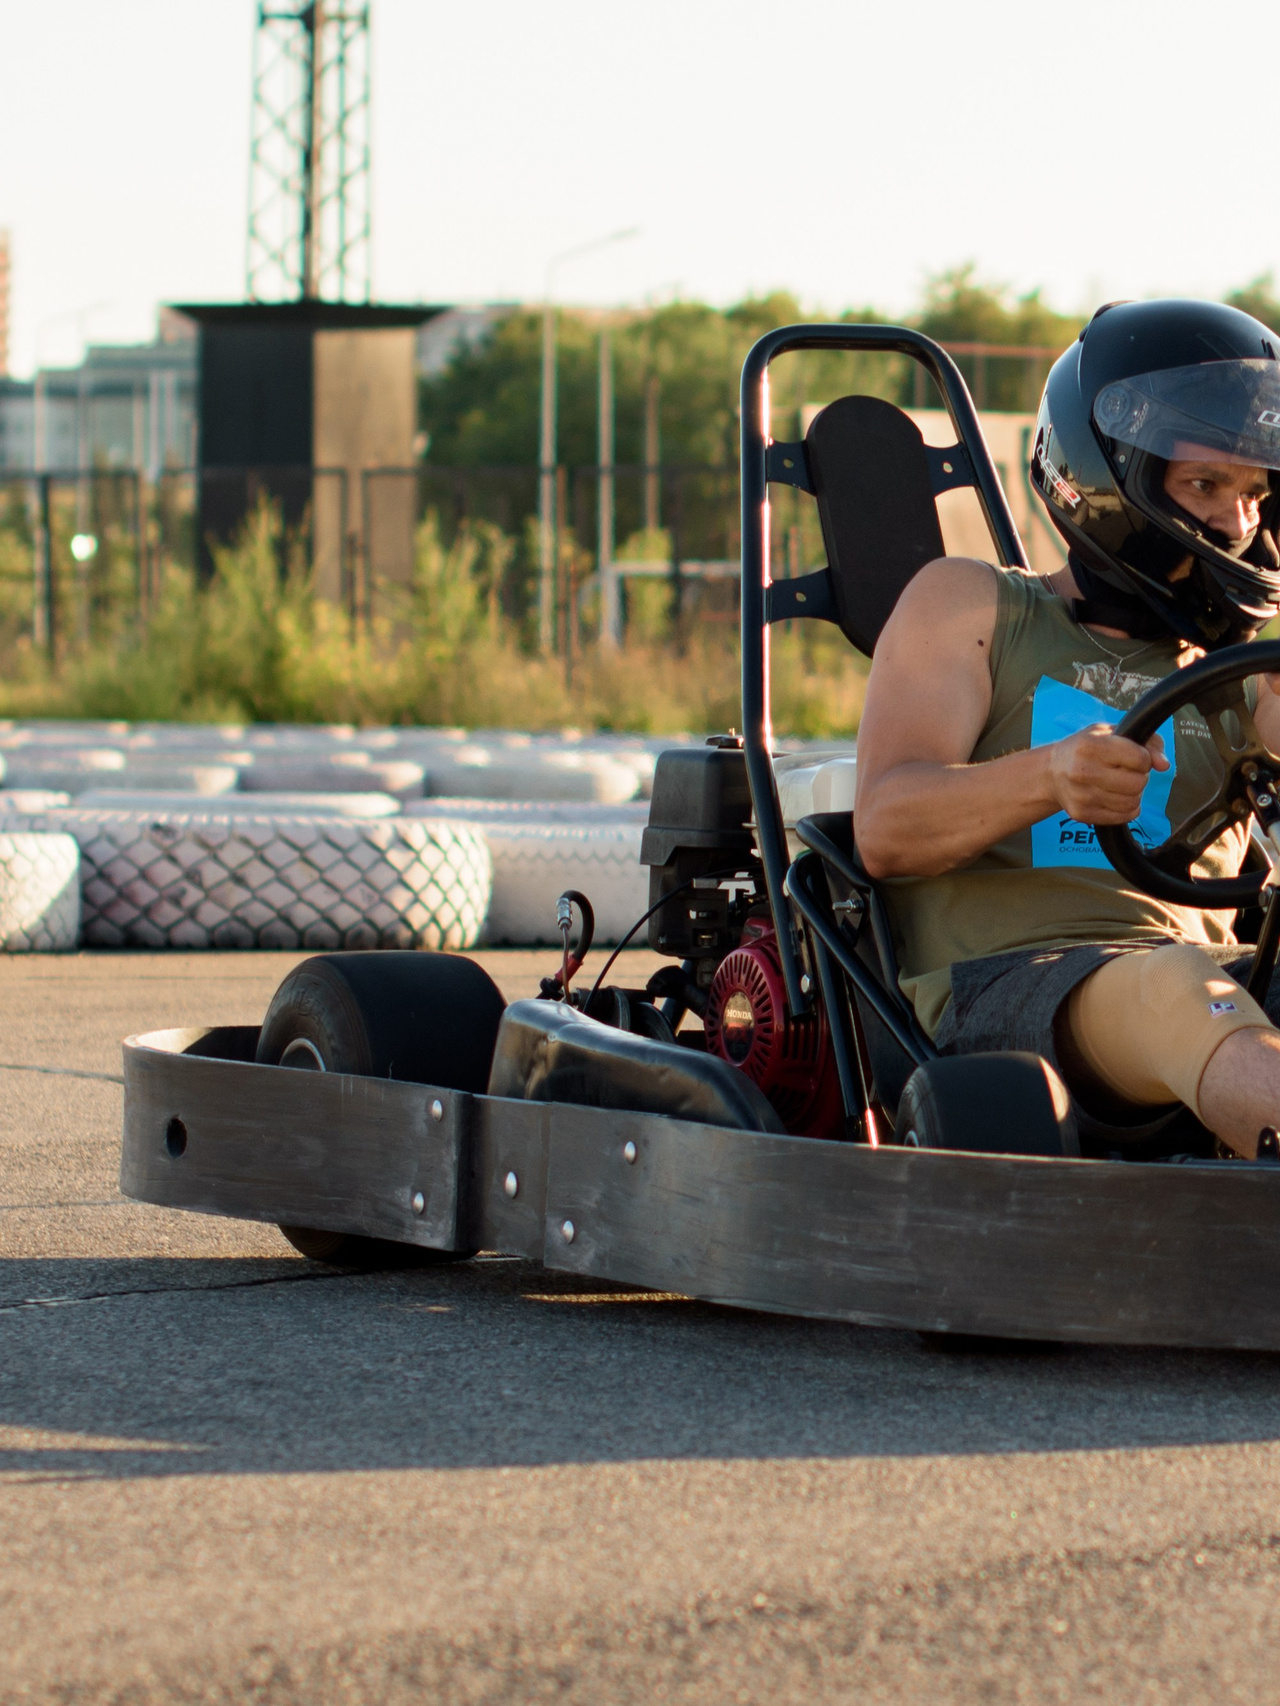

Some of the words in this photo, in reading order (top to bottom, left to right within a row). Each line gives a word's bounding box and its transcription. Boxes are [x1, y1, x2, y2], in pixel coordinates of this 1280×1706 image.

[1180, 728, 1195, 736] THE
[1197, 730, 1211, 740] DAY
[726, 1008, 753, 1020] HONDA
